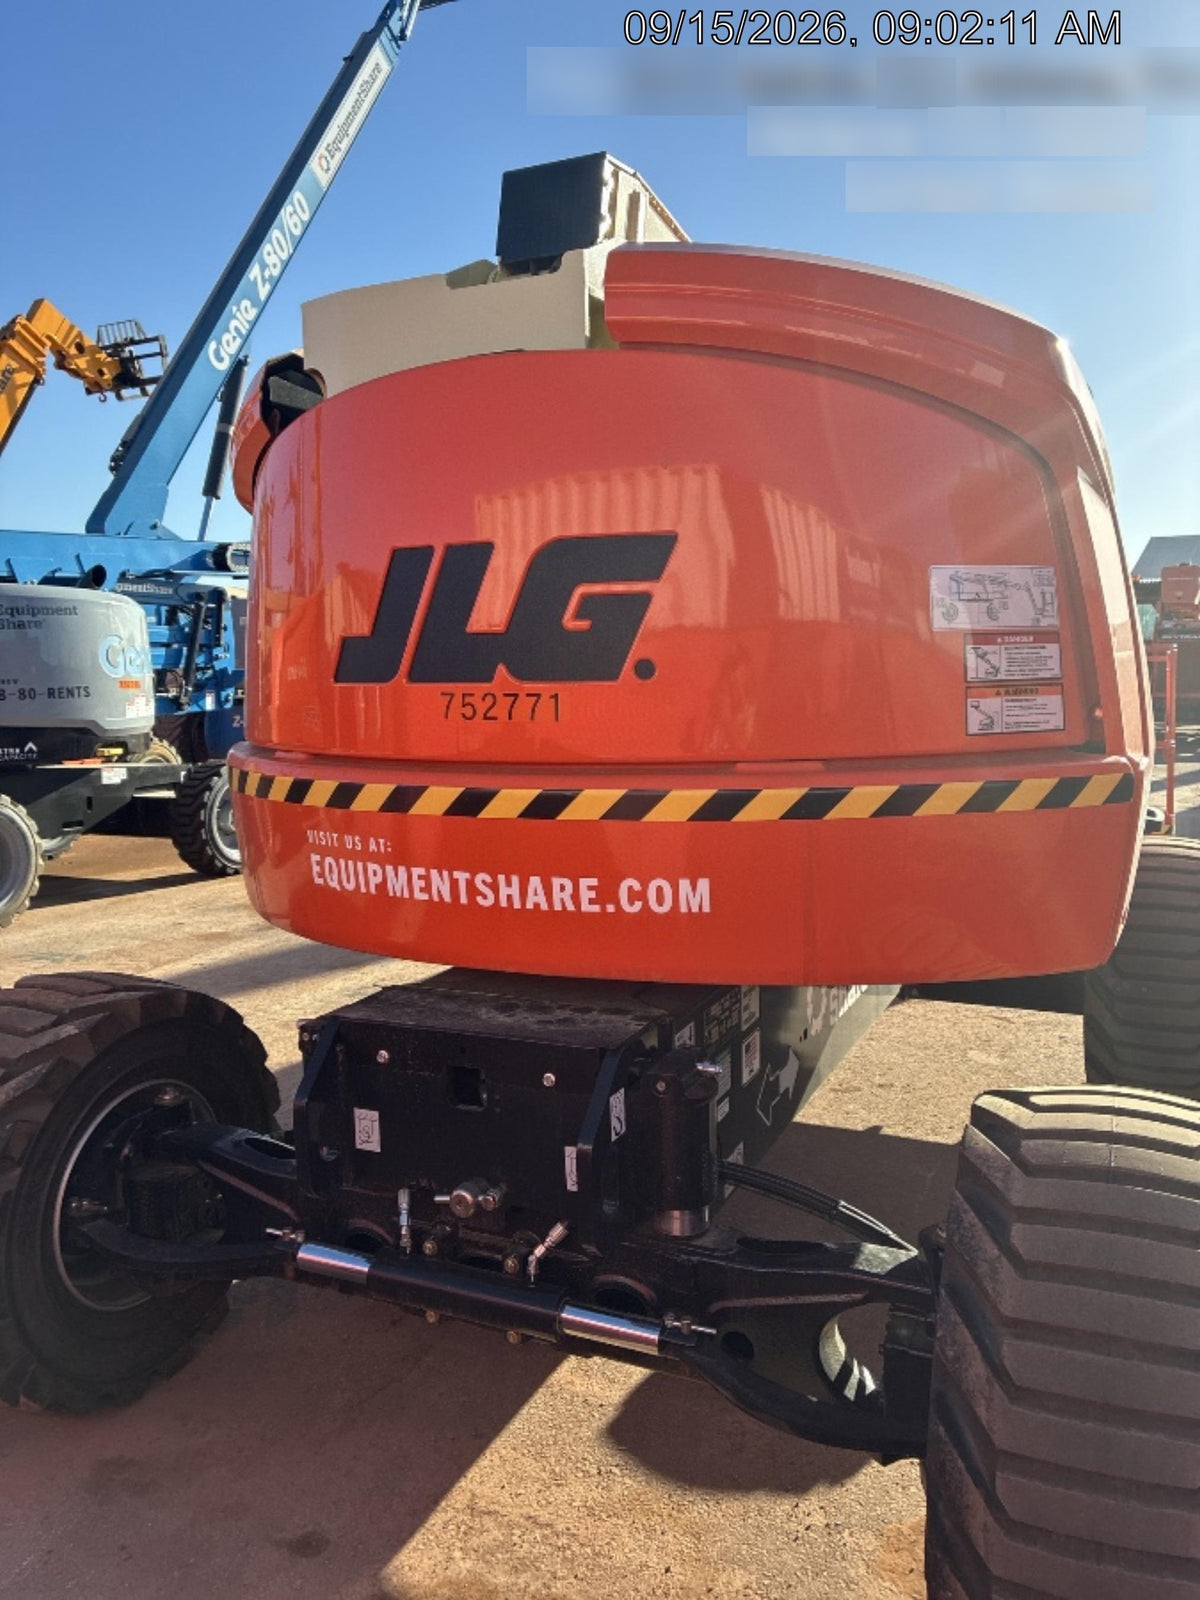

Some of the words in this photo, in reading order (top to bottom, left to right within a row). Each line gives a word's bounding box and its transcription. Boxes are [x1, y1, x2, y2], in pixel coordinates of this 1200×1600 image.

[325, 62, 382, 160] EquipmentShare
[208, 299, 258, 371] Genie
[249, 191, 310, 302] Z-80/60
[440, 692, 560, 723] 752771
[306, 829, 339, 848] VISIT
[344, 835, 362, 851] US
[369, 837, 392, 854] AT:
[310, 852, 712, 913] EQUIPMENTSHARE.COM
